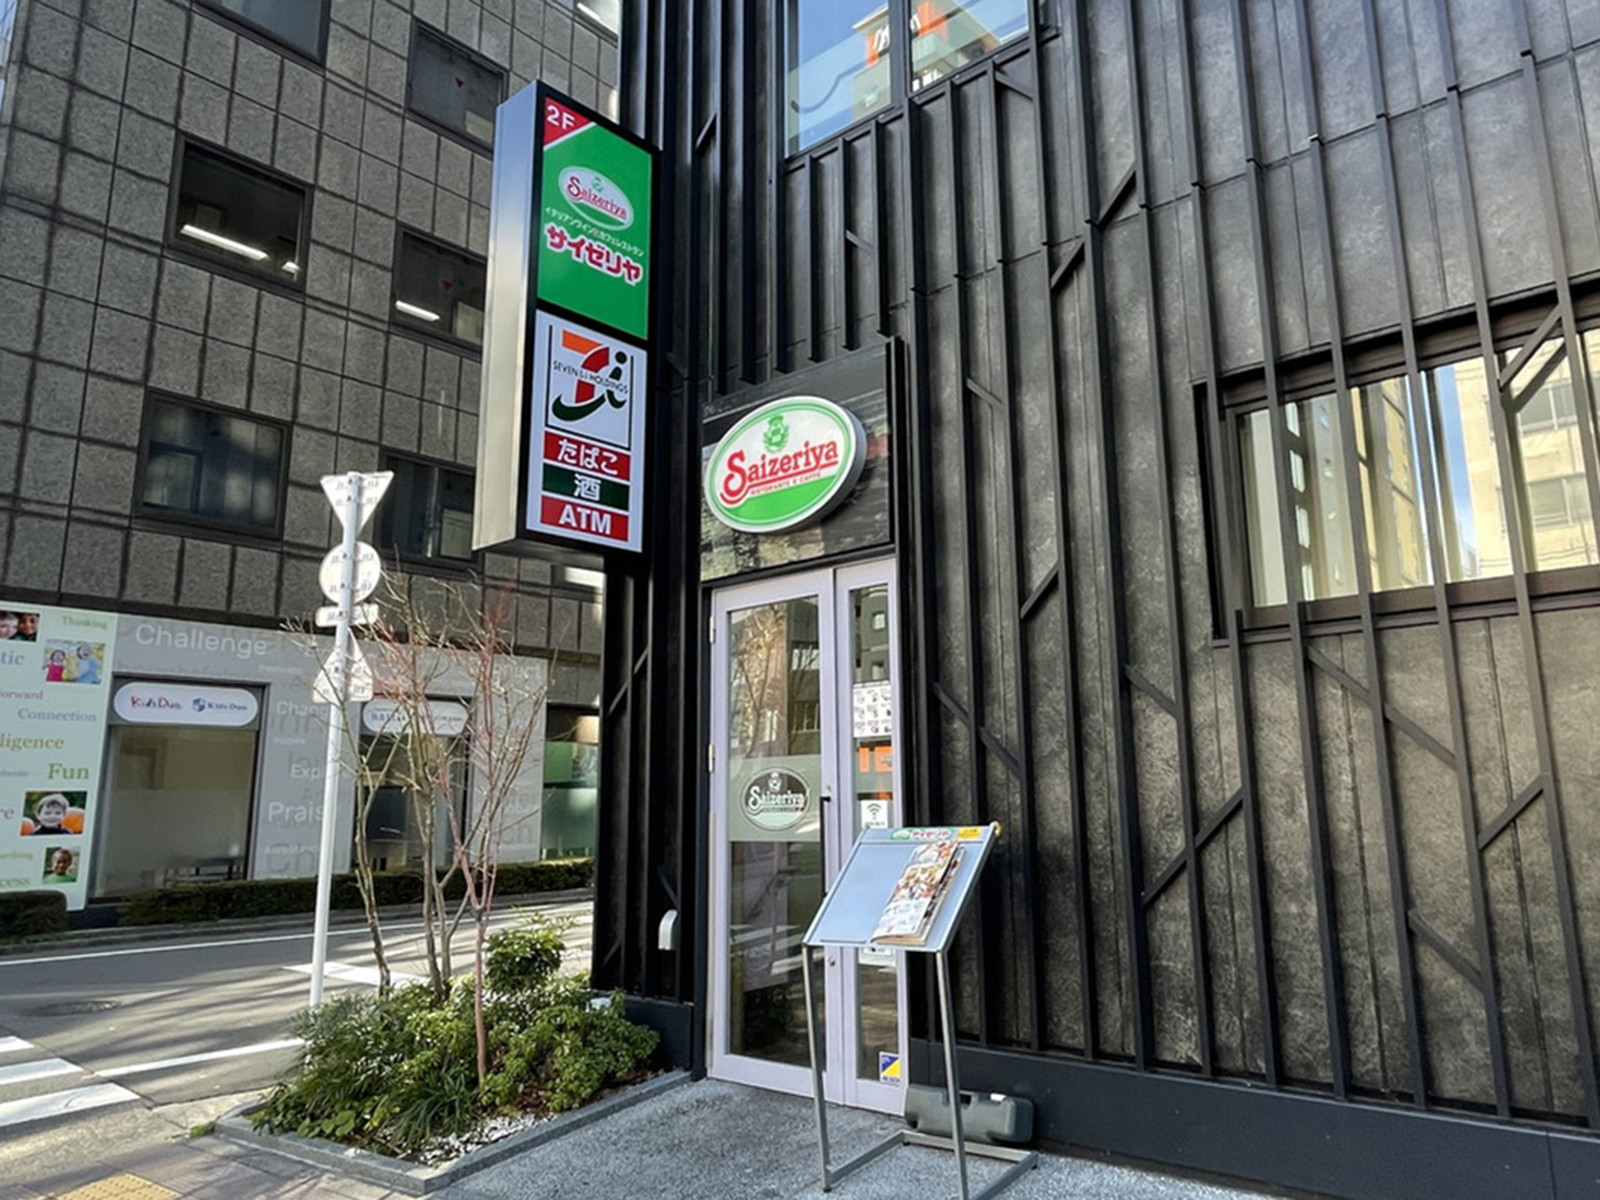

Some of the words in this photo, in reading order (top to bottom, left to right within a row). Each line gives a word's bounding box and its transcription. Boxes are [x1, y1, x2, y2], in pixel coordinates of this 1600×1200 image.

[547, 104, 575, 129] 2F
[565, 175, 628, 220] Saizeriya
[545, 222, 643, 285] サイゼリヤ
[557, 438, 618, 475] たばこ
[574, 473, 601, 501] 酒
[720, 440, 839, 505] Saizeriya
[558, 504, 612, 535] ATM
[62, 616, 108, 630] Thinking
[135, 623, 268, 659] Challenge
[17, 708, 98, 722] Connection
[47, 762, 90, 780] Fun
